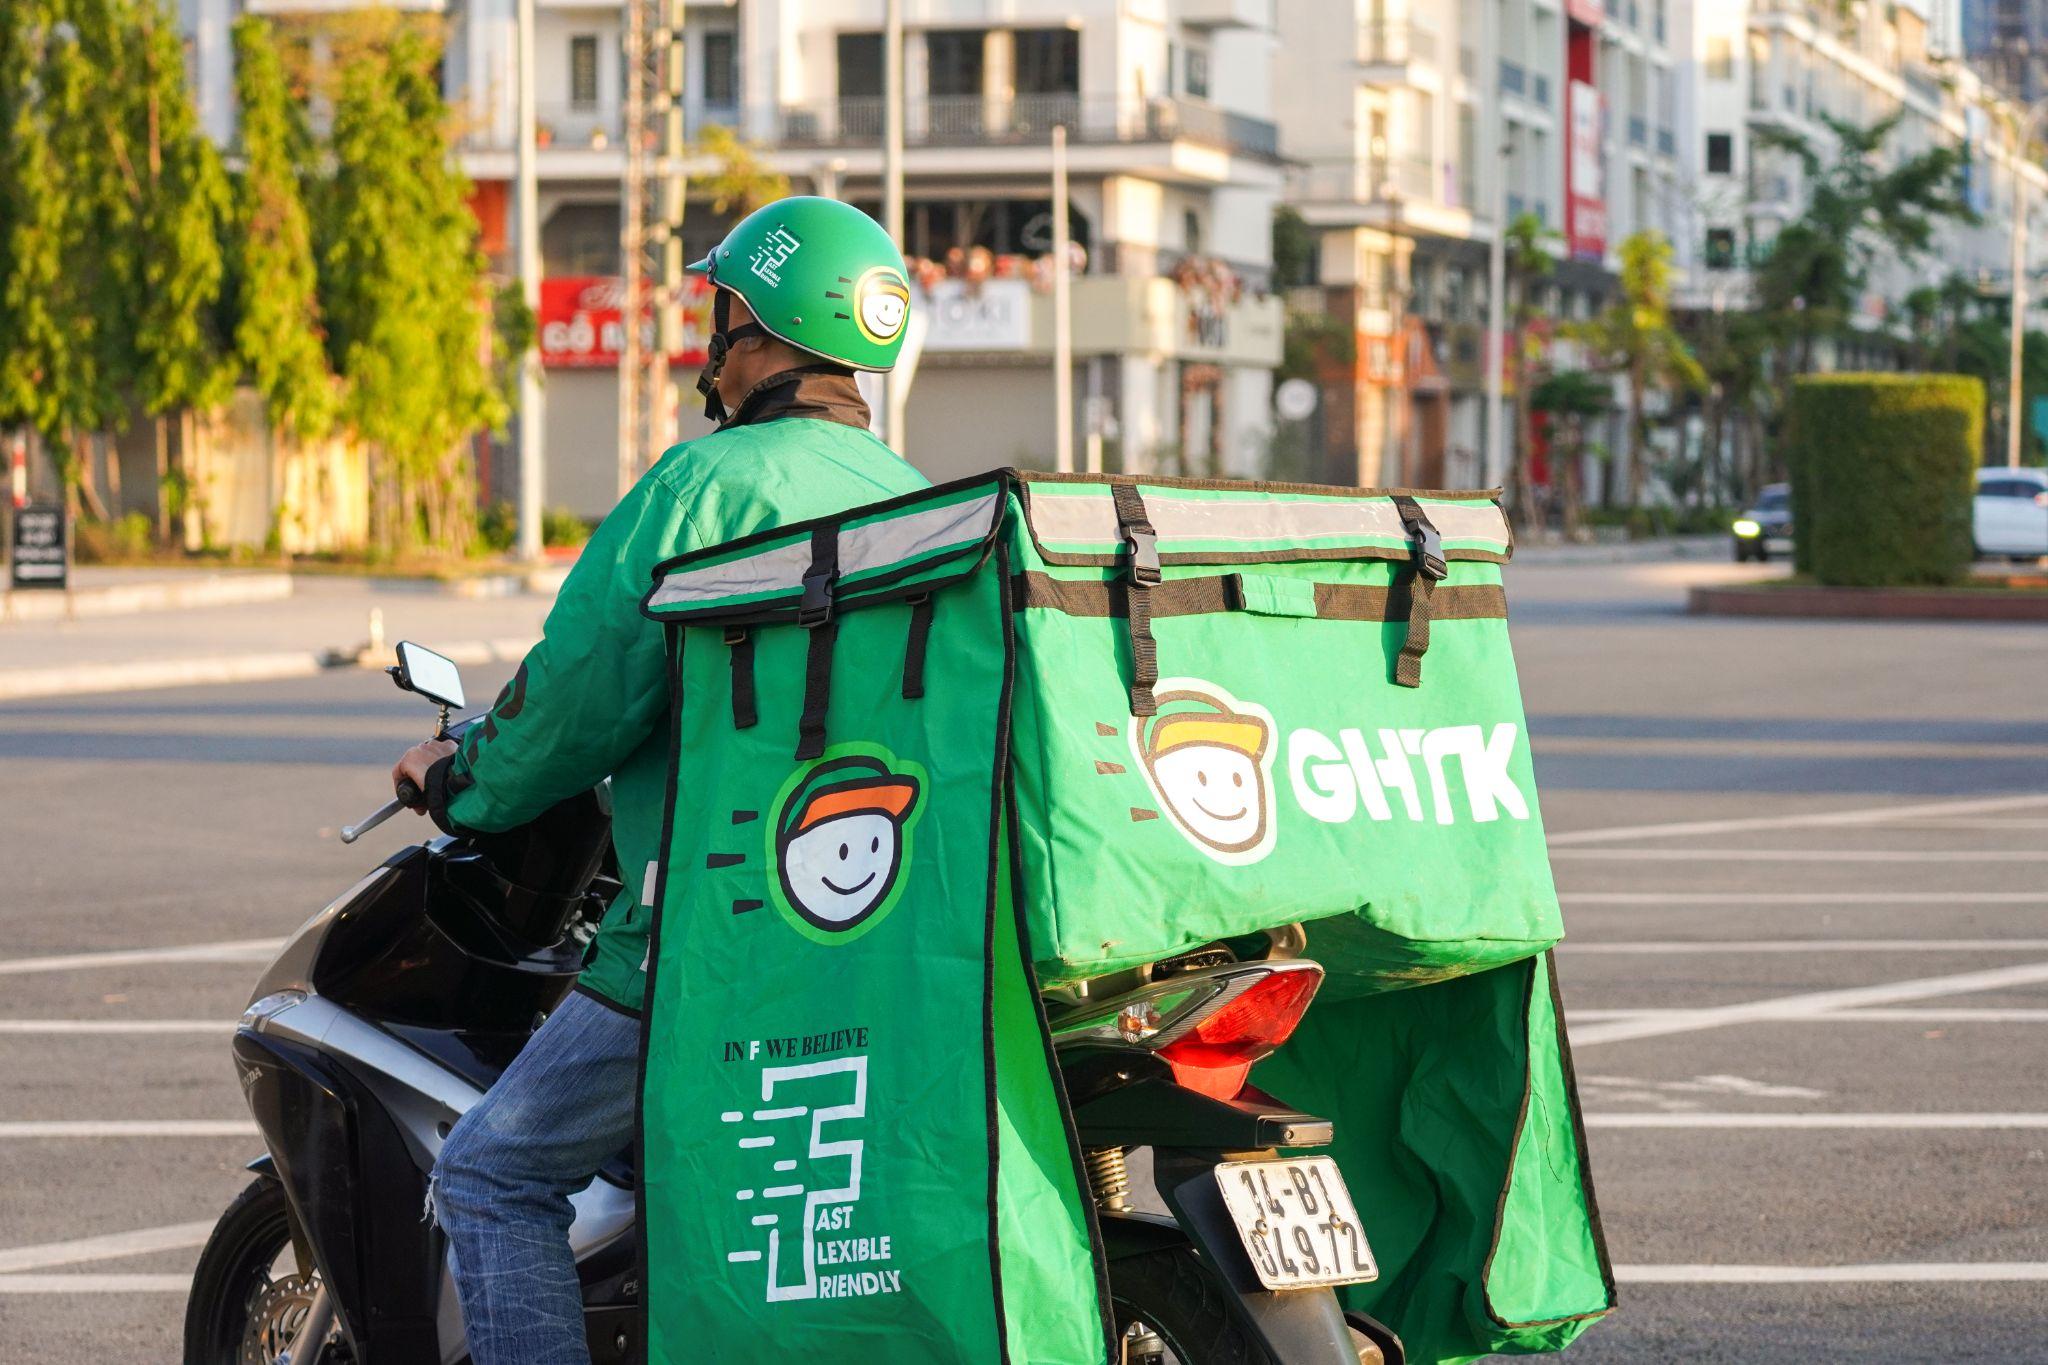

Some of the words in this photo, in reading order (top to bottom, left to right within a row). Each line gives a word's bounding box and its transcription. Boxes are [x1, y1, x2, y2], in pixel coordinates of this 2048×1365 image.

[1288, 722, 1530, 825] GHTK
[724, 1041, 745, 1062] IN
[749, 1040, 760, 1060] F
[766, 1038, 798, 1058] WE
[801, 1027, 869, 1056] BELIEVE
[1240, 1165, 1336, 1218] 14-B1
[815, 1205, 854, 1232] AST
[817, 1236, 892, 1265] LEXIBLE
[819, 1270, 902, 1299] RIENDLY
